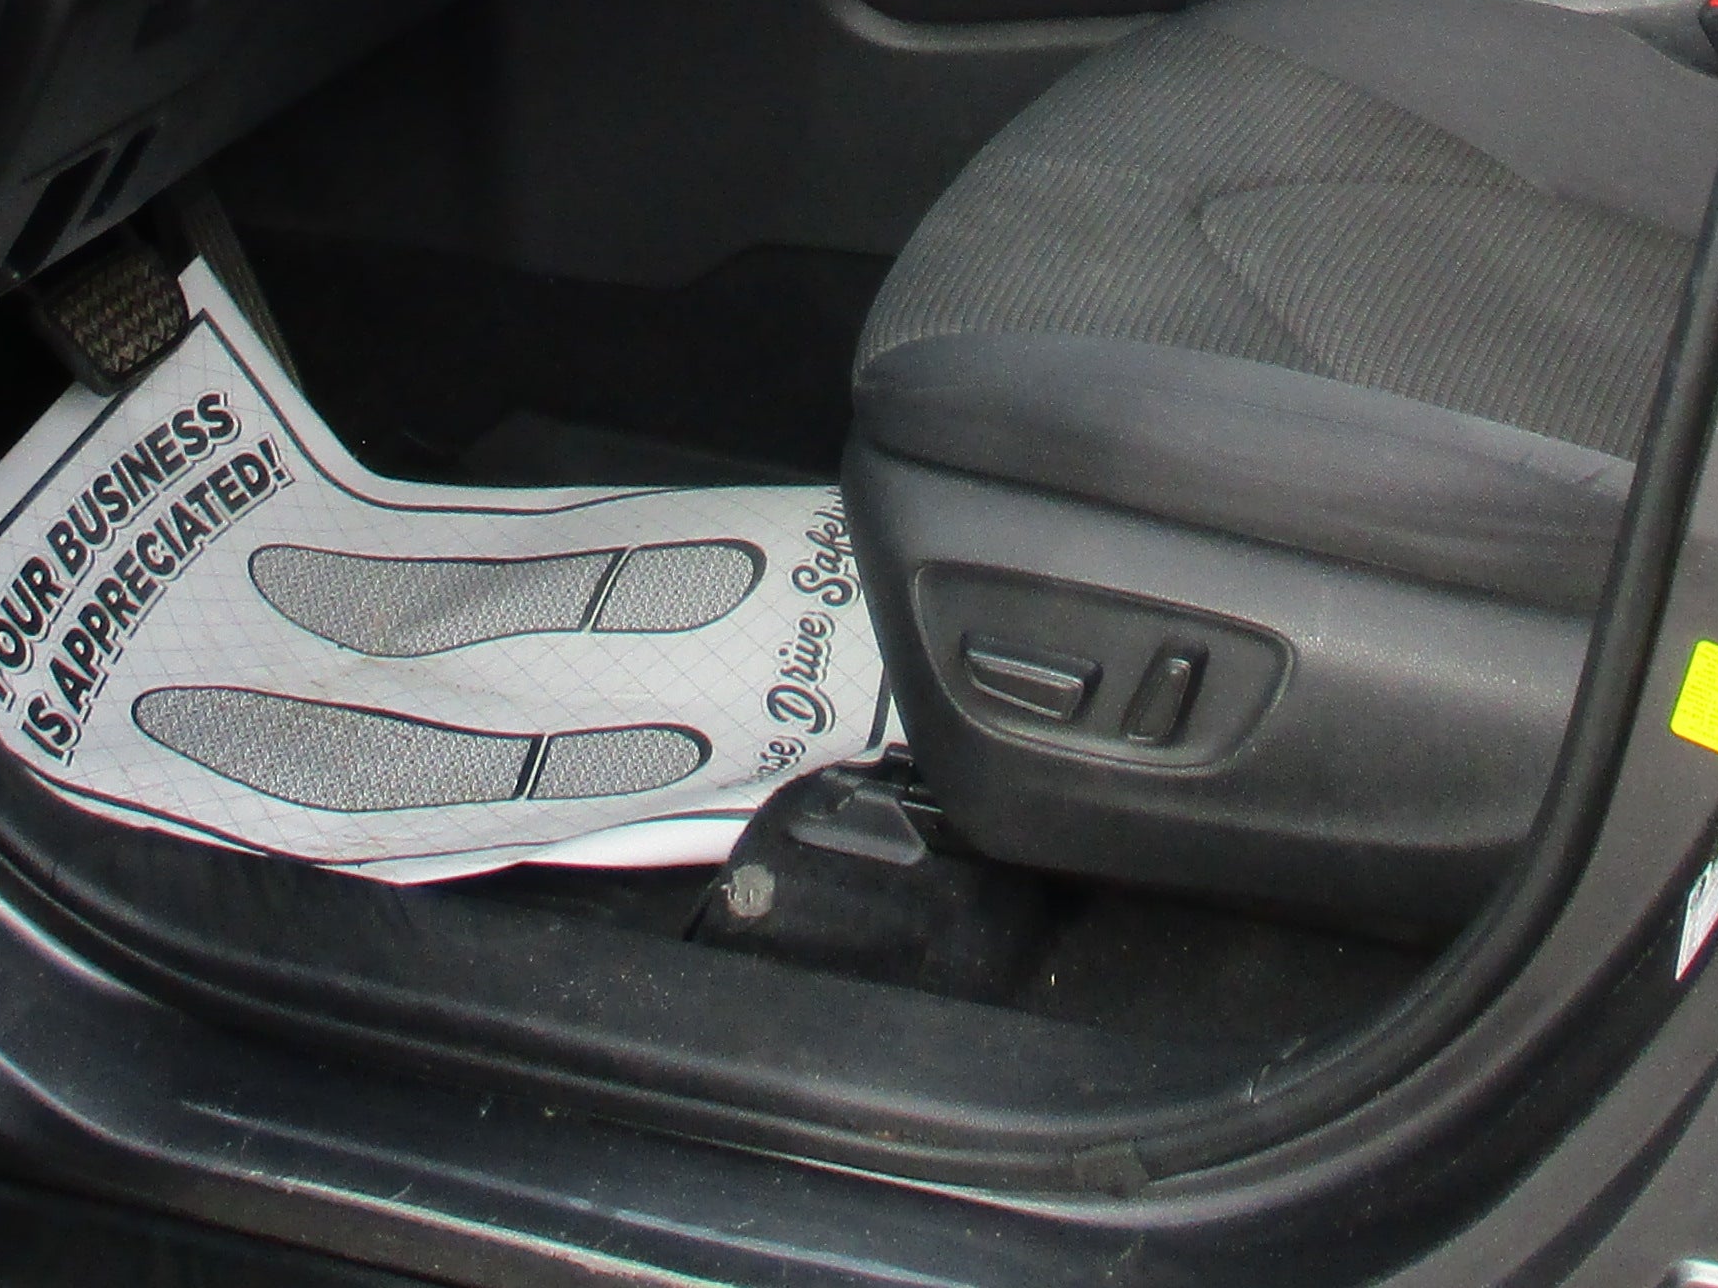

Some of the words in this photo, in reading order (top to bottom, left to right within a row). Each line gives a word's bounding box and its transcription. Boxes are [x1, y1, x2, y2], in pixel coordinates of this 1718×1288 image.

[46, 392, 240, 585] BUSINESS
[50, 438, 294, 722] APPRECIATED!
[21, 695, 80, 765] IS
[766, 612, 835, 735] Drive
